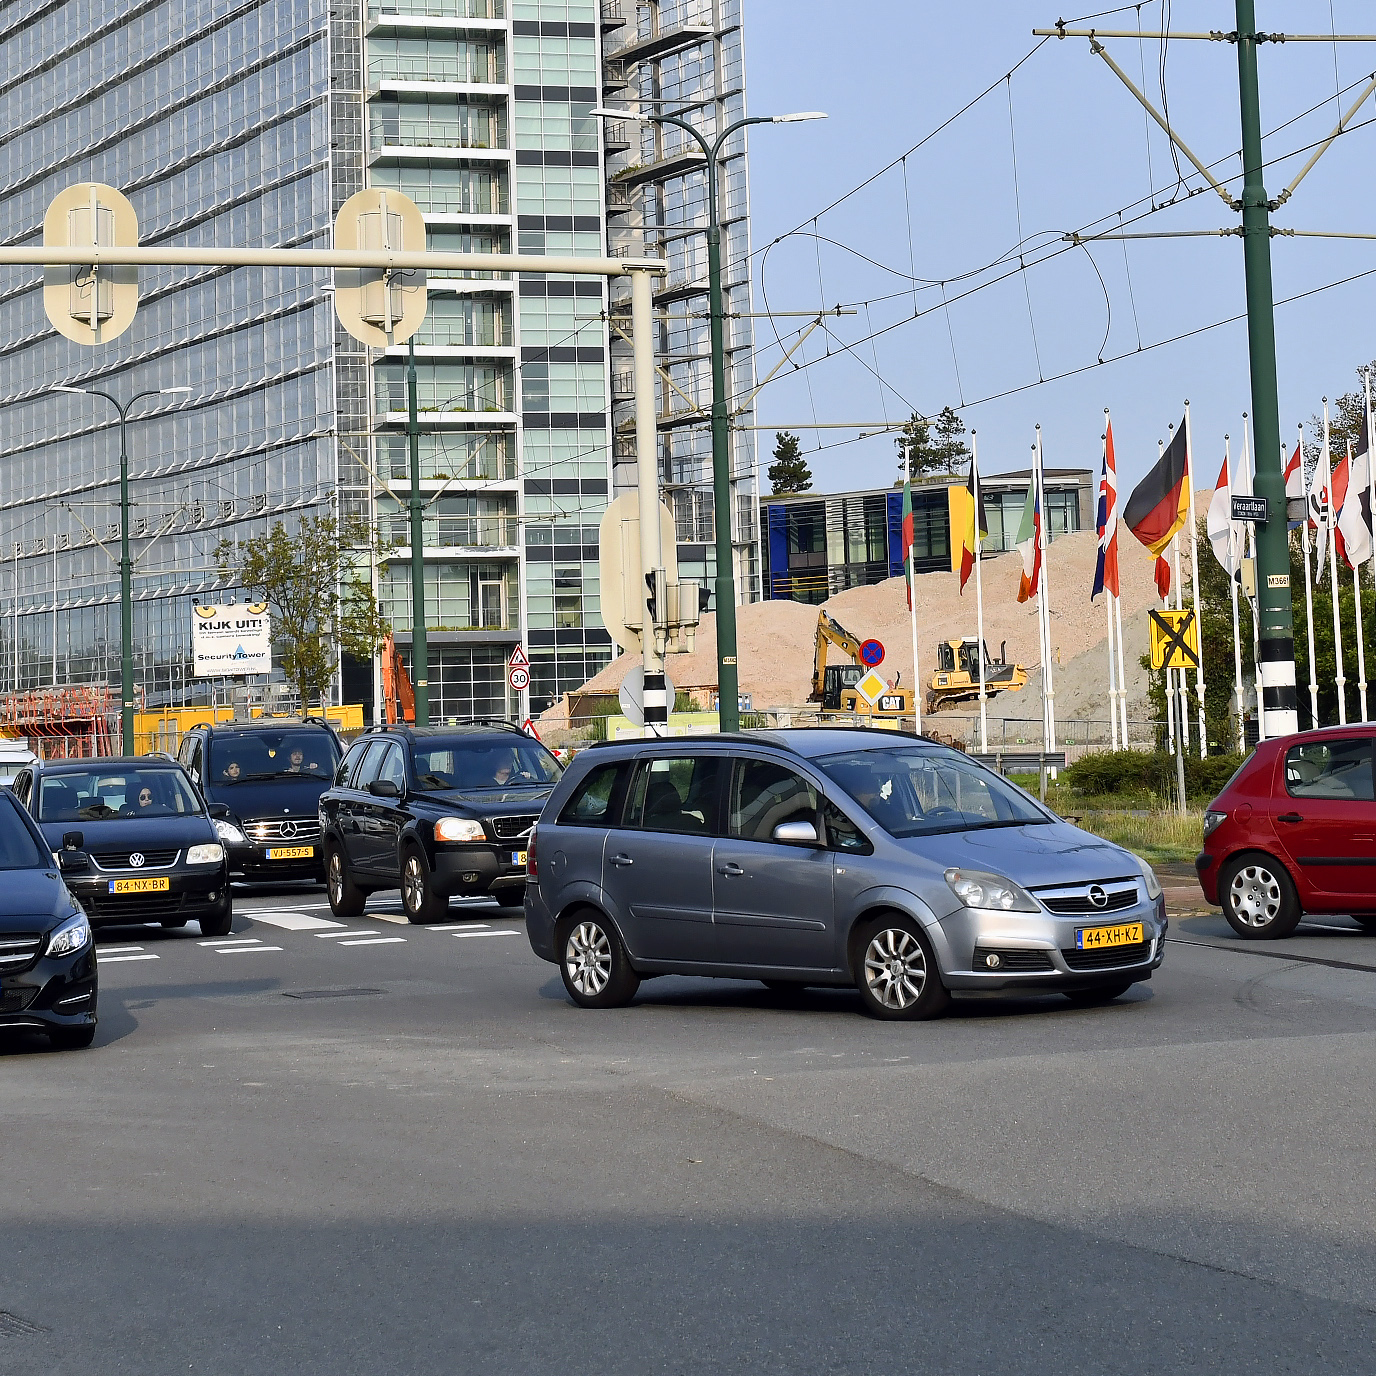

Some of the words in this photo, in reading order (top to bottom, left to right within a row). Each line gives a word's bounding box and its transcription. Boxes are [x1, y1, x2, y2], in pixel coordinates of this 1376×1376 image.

[198, 621, 231, 631] KIJK
[235, 619, 262, 628] UIT!
[197, 652, 266, 661] SecurityTower
[513, 674, 526, 684] 30
[882, 696, 901, 710] CAT
[116, 879, 165, 891] 84-NX-BR
[1087, 927, 1139, 945] 44-XH-KZ
